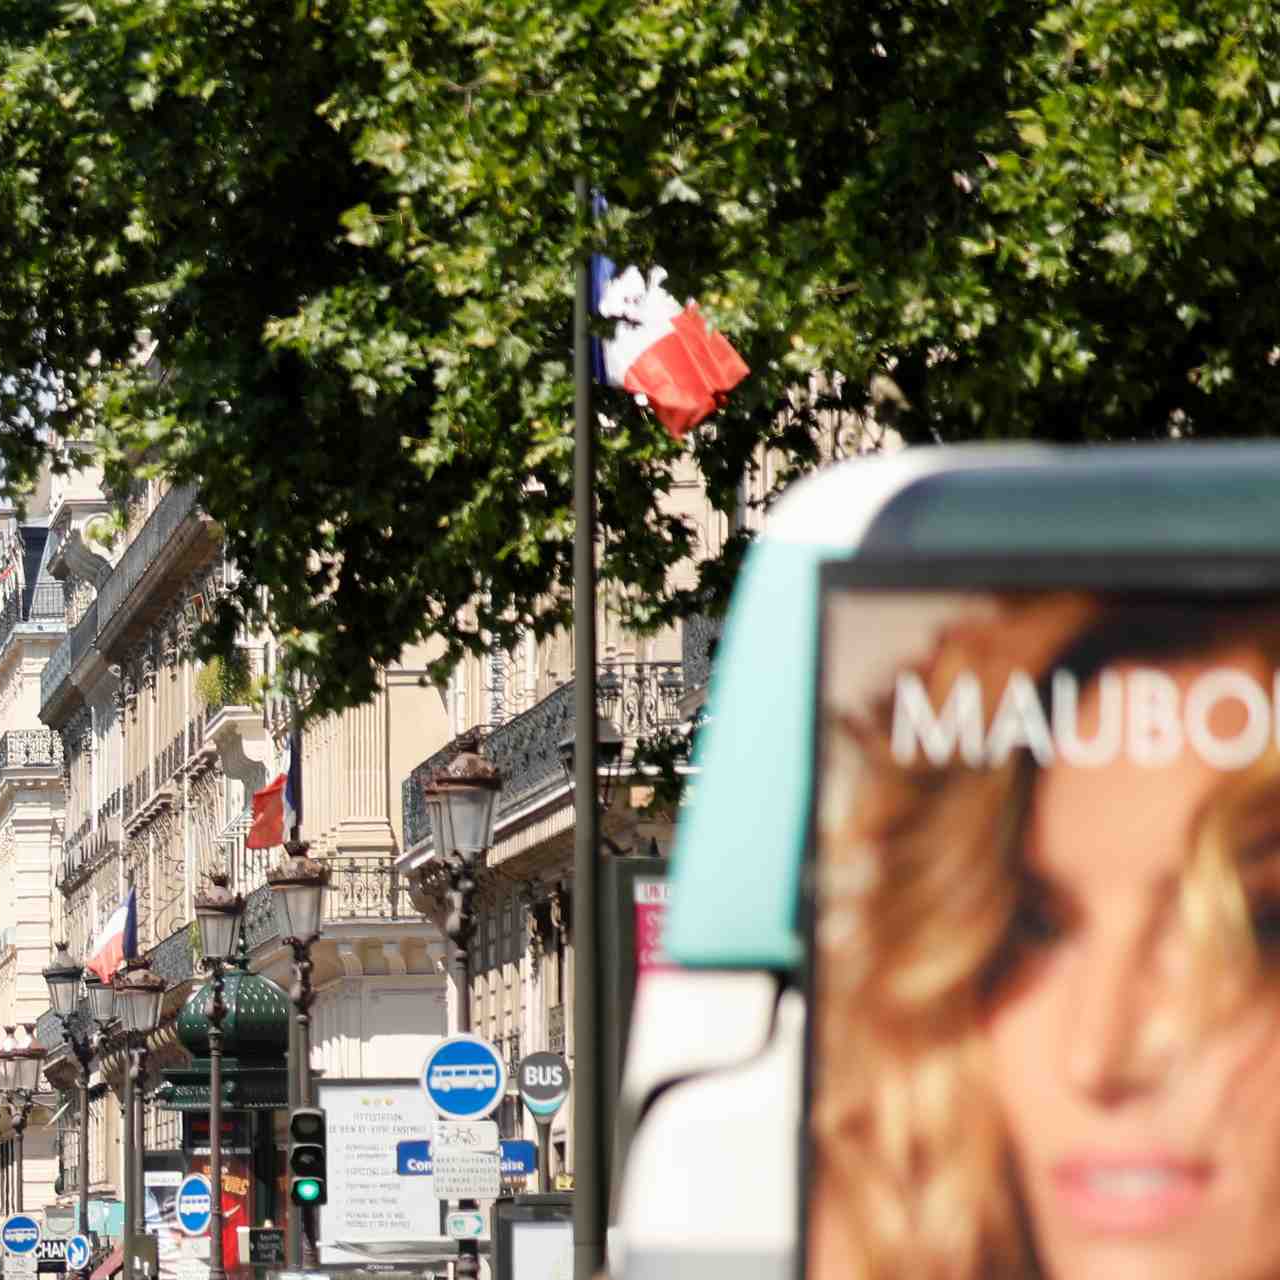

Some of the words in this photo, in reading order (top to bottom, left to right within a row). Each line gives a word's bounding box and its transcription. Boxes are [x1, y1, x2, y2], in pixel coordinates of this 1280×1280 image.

[891, 667, 1280, 772] MAUBO
[525, 1066, 563, 1086] BUS
[33, 1241, 69, 1258] CHAN
